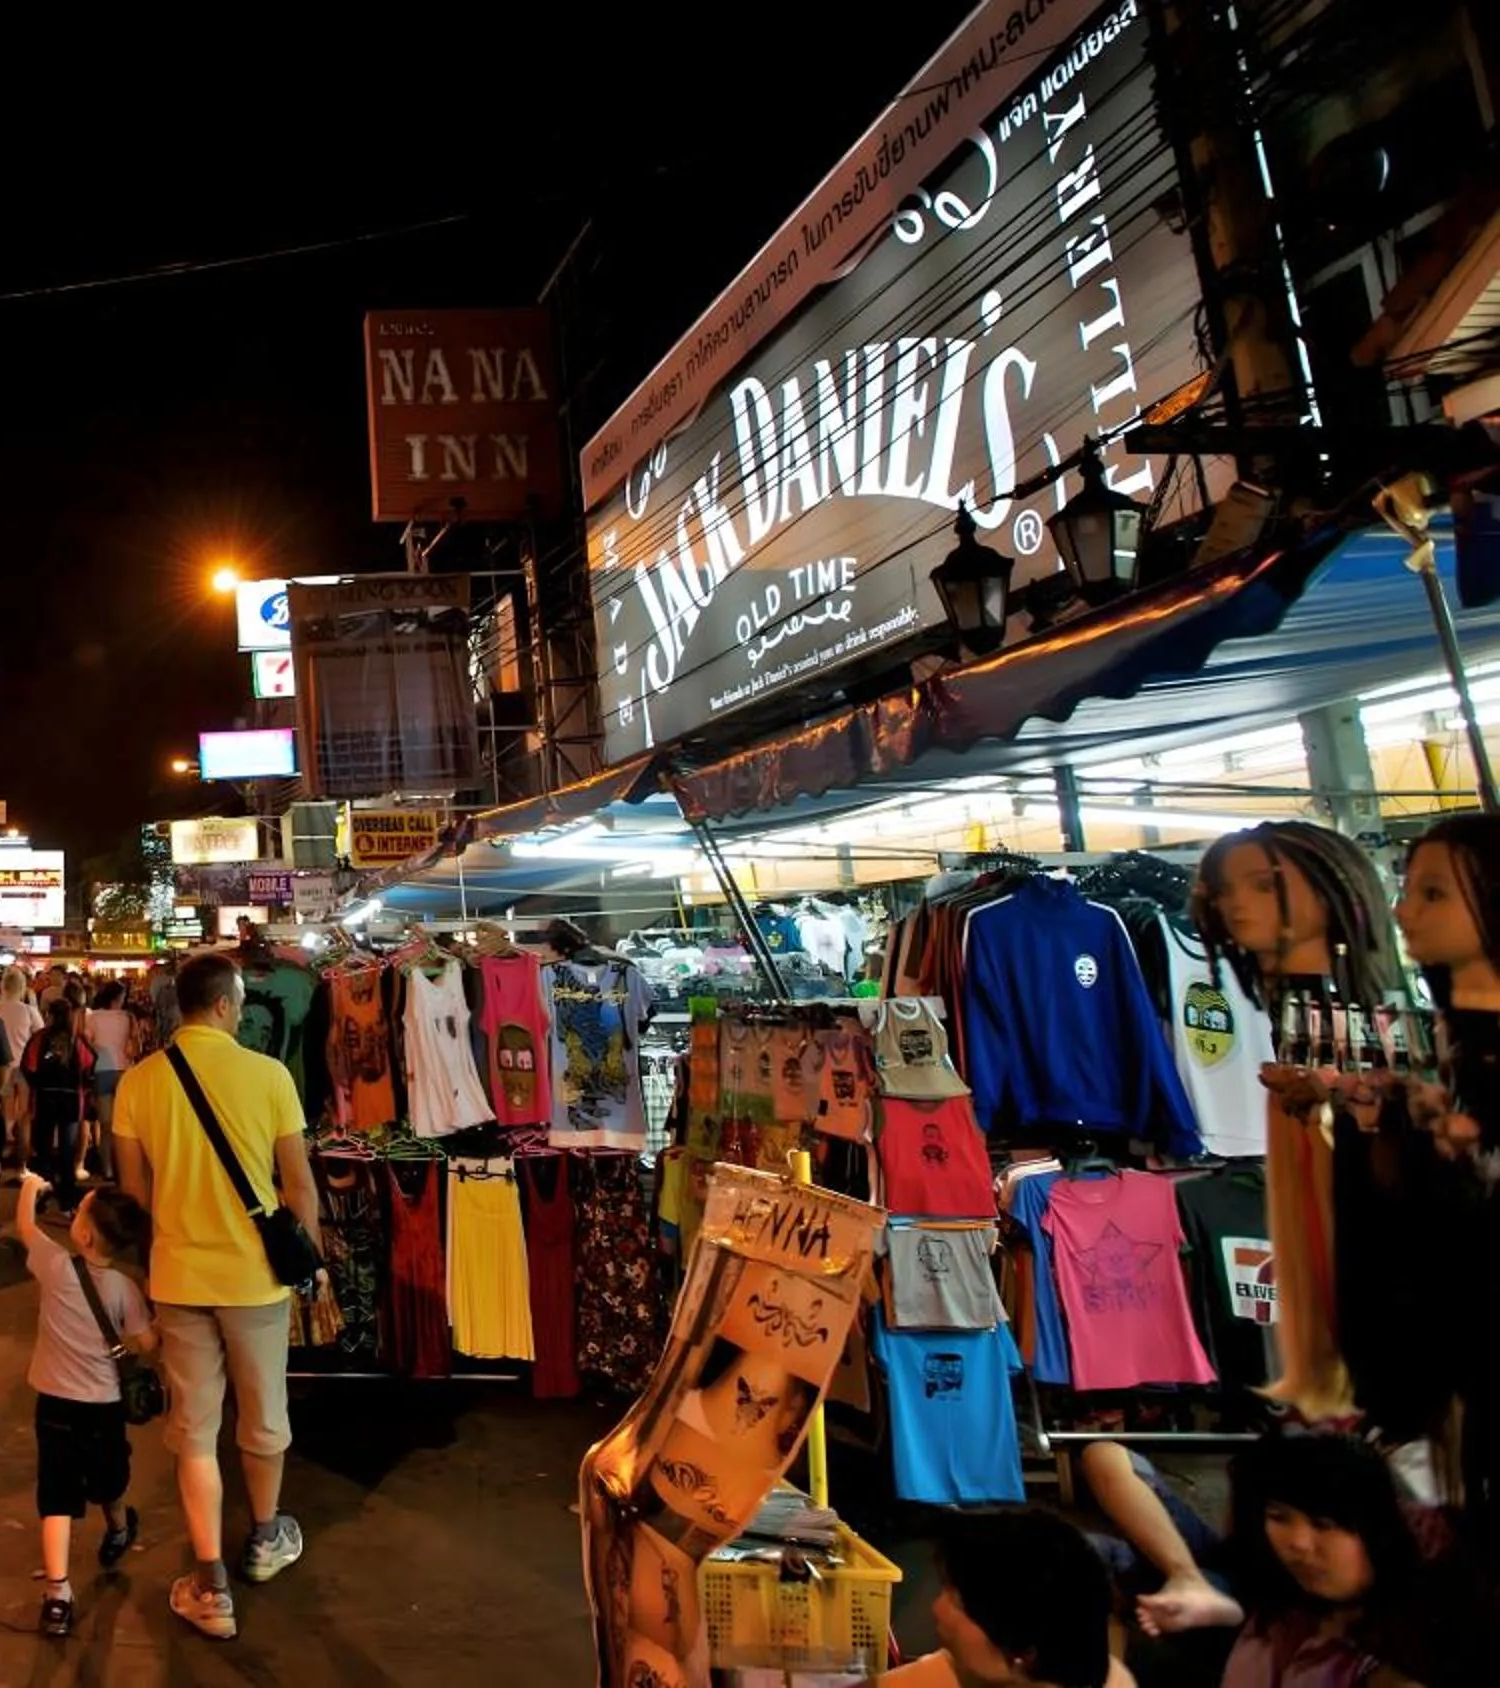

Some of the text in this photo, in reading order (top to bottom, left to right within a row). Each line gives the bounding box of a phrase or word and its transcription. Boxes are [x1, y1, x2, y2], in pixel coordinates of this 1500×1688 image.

[404, 433, 530, 481] INN
[633, 450, 747, 695] JACK
[729, 290, 1038, 529] DANIEL'S
[736, 586, 781, 646] OLD
[790, 557, 858, 600] TIME
[352, 815, 432, 832] OVERSEAS CALL
[377, 834, 435, 853] INTERNET
[1235, 1281, 1278, 1301] ELEVE
